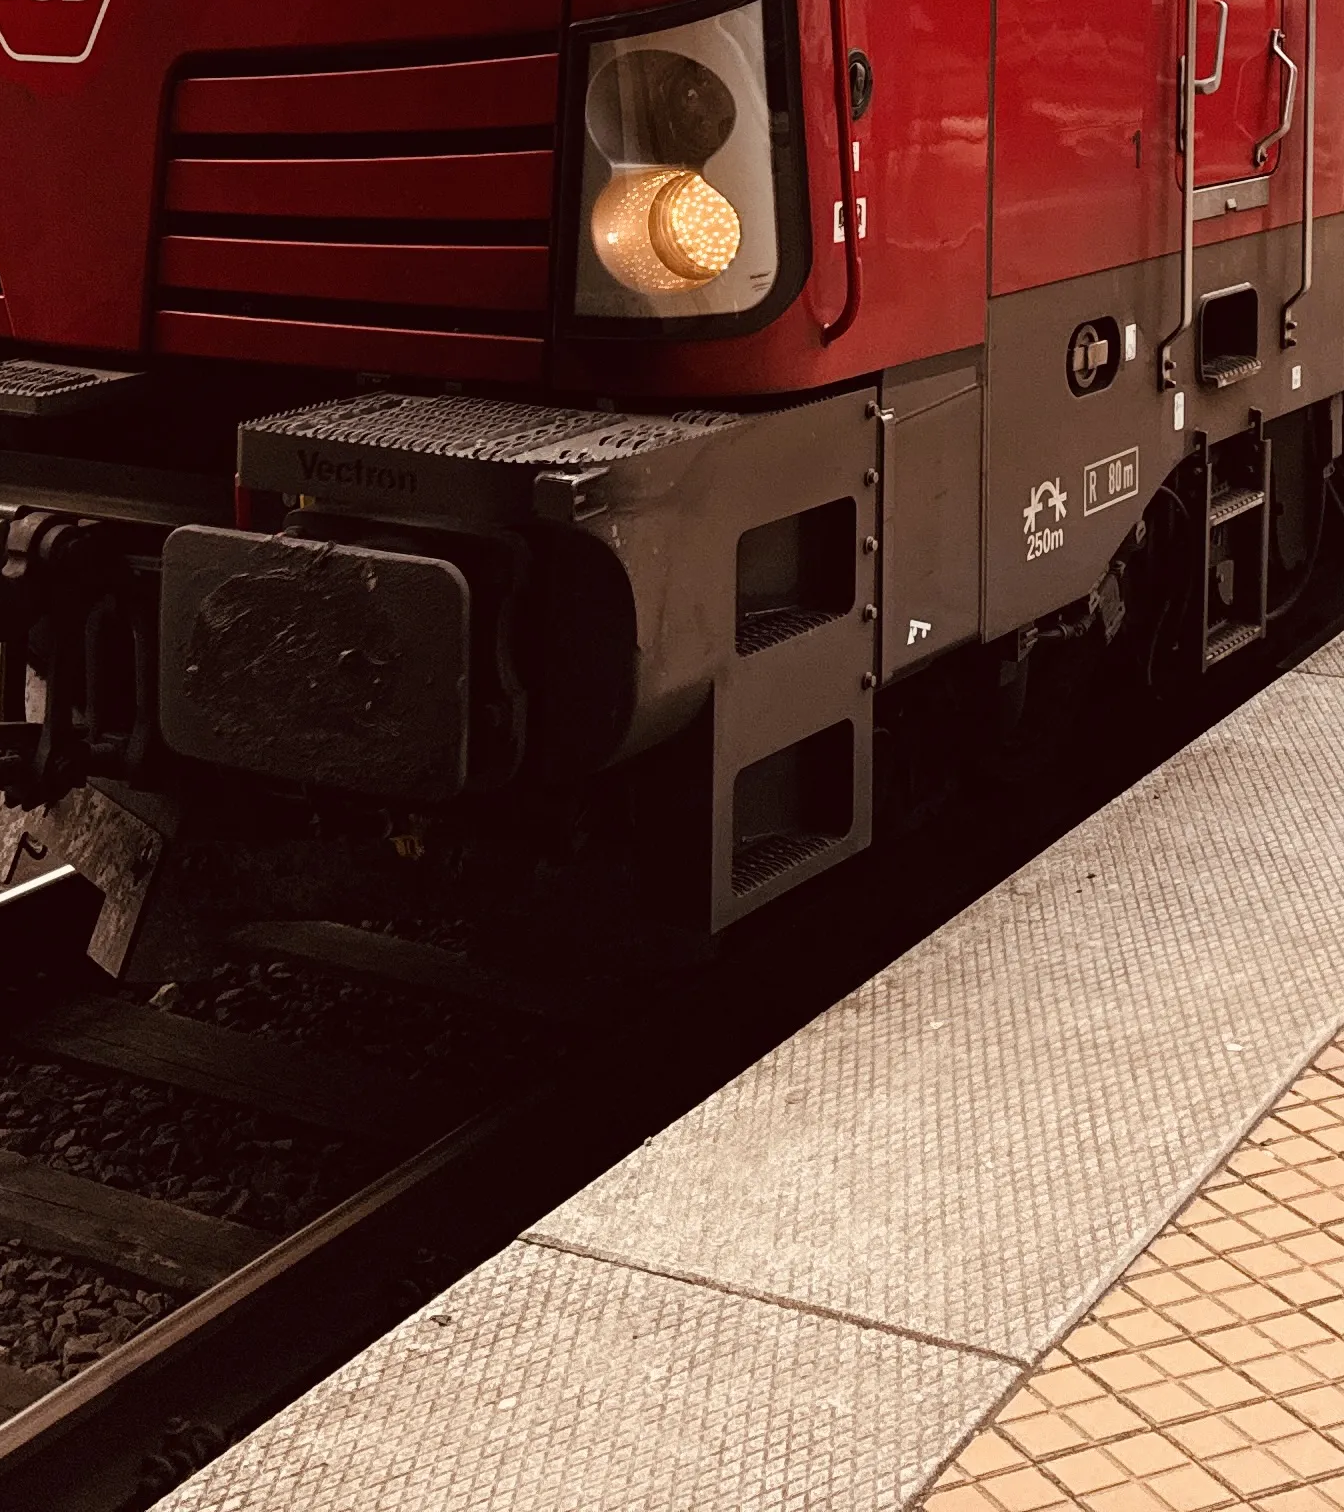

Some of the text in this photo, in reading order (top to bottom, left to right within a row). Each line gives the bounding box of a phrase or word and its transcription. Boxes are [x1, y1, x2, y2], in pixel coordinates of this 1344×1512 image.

[297, 449, 417, 492] Vectron
[1089, 470, 1097, 504] R
[1026, 527, 1064, 561] 250m
